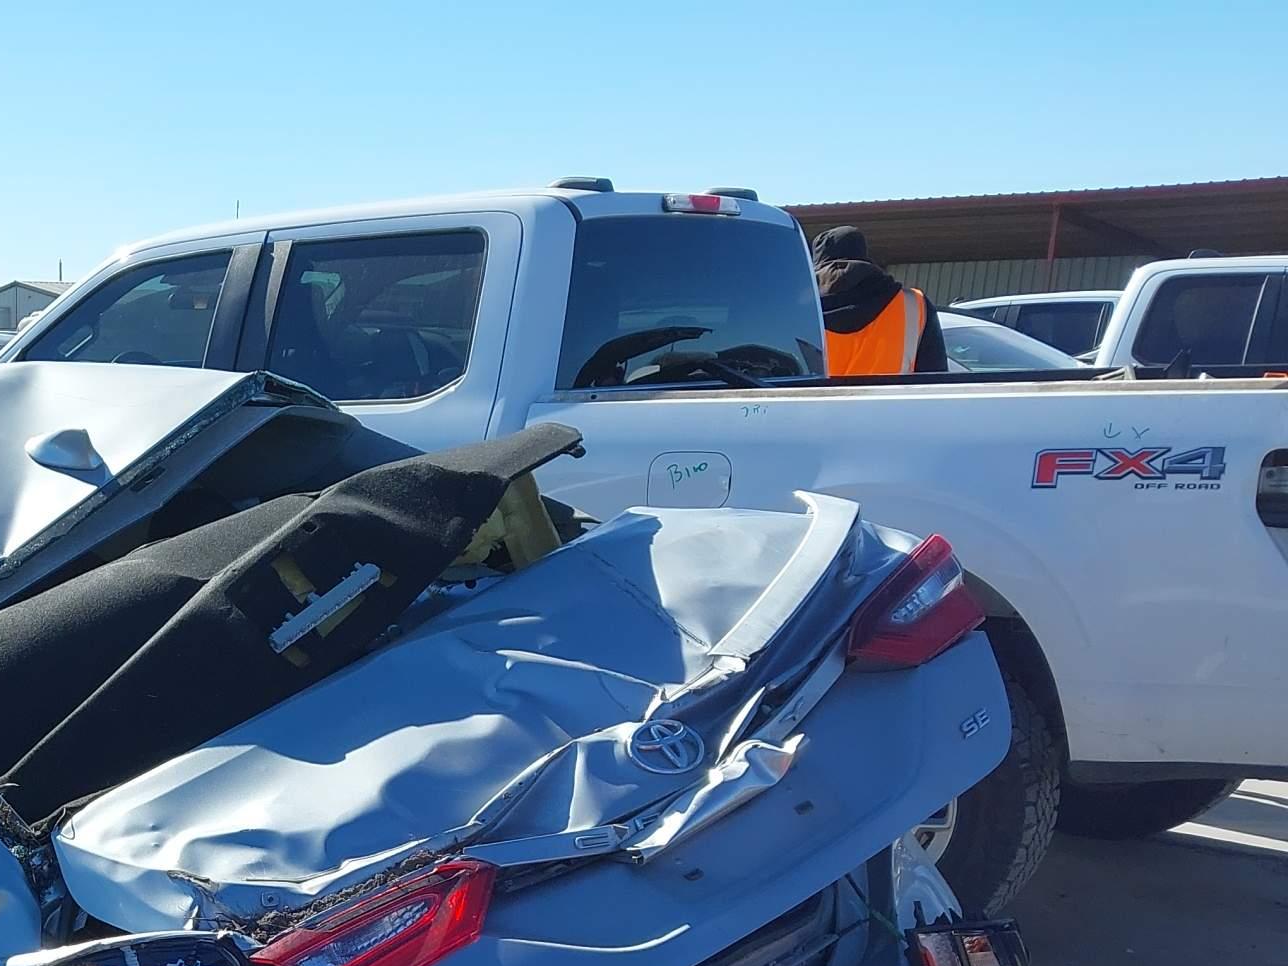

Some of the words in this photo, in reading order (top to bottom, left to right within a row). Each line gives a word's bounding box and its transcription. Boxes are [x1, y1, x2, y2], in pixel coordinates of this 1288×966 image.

[1031, 446, 1226, 489] FX4
[1133, 482, 1169, 490] OFF
[1174, 482, 1221, 490] ROAD
[960, 708, 990, 739] SE
